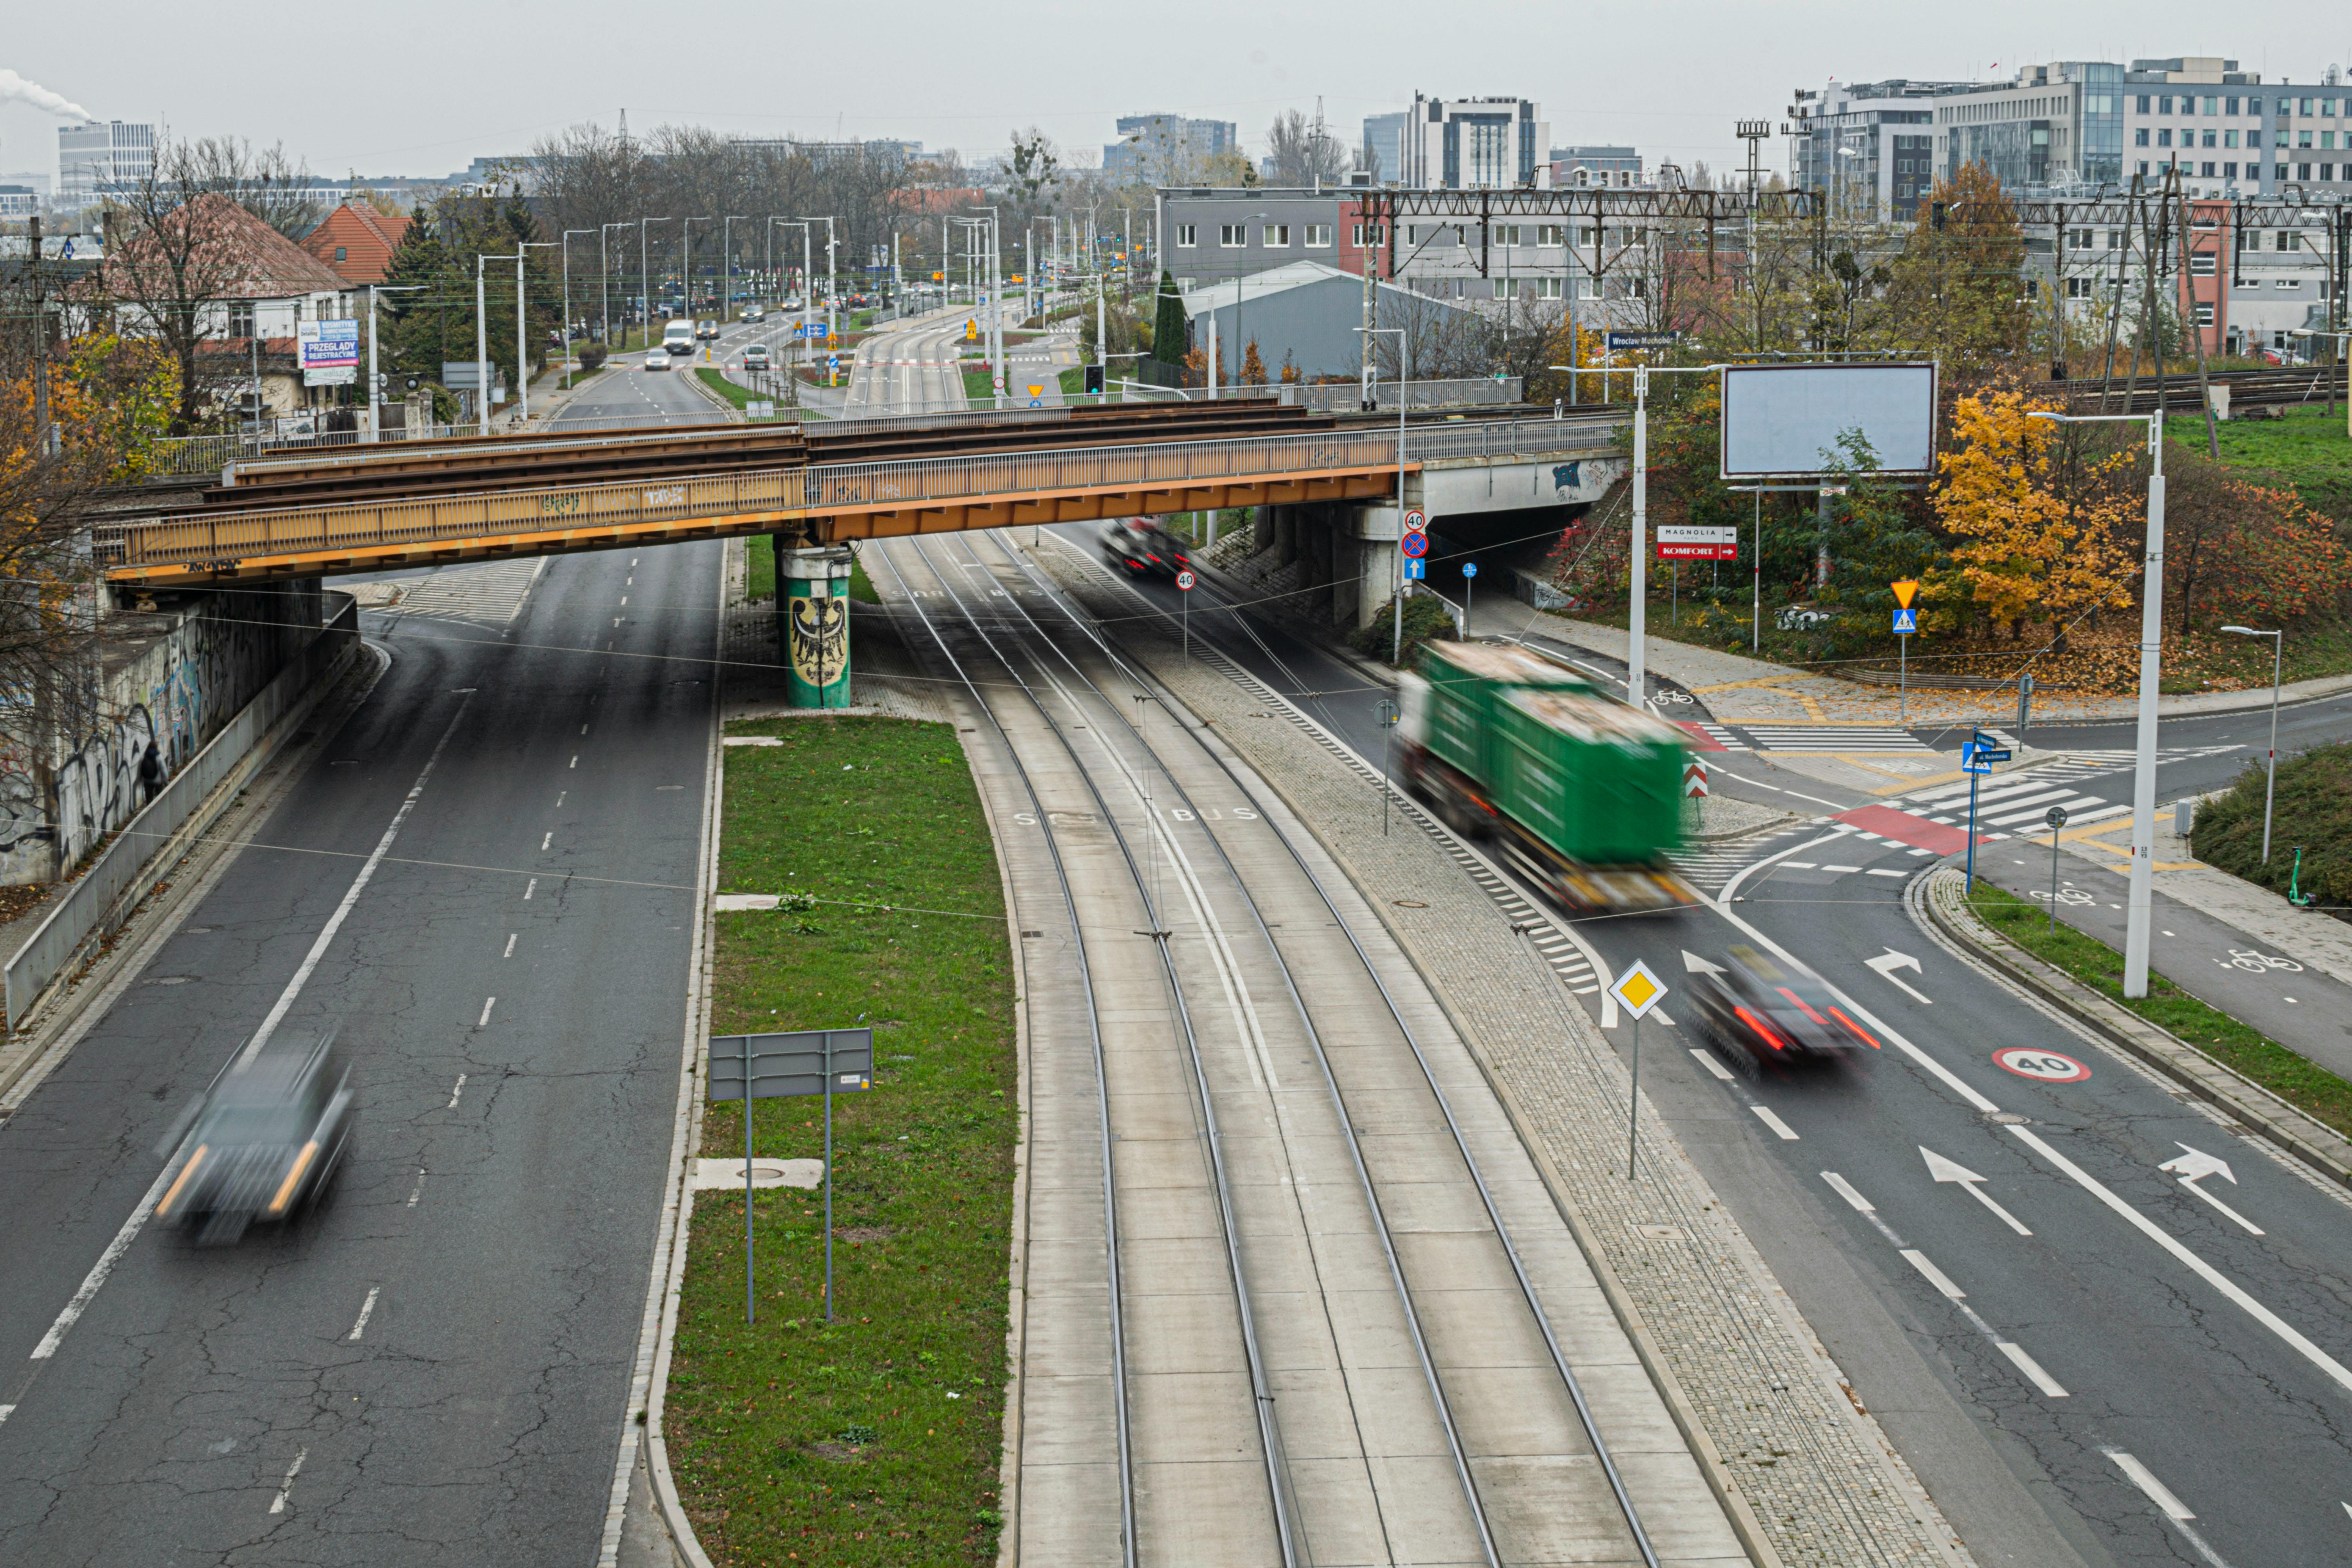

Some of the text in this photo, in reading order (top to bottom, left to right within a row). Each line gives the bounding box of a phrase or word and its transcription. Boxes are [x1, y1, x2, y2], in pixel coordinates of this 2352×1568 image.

[1641, 336, 1673, 344] Muchobór
[309, 342, 355, 352] PRZEGLĄDY
[309, 351, 356, 359] REJESTRACYJNE
[1408, 516, 1423, 525] 40
[1179, 575, 1193, 585] 40
[1171, 808, 1258, 821] BUS
[2017, 1058, 2071, 1071] 40
